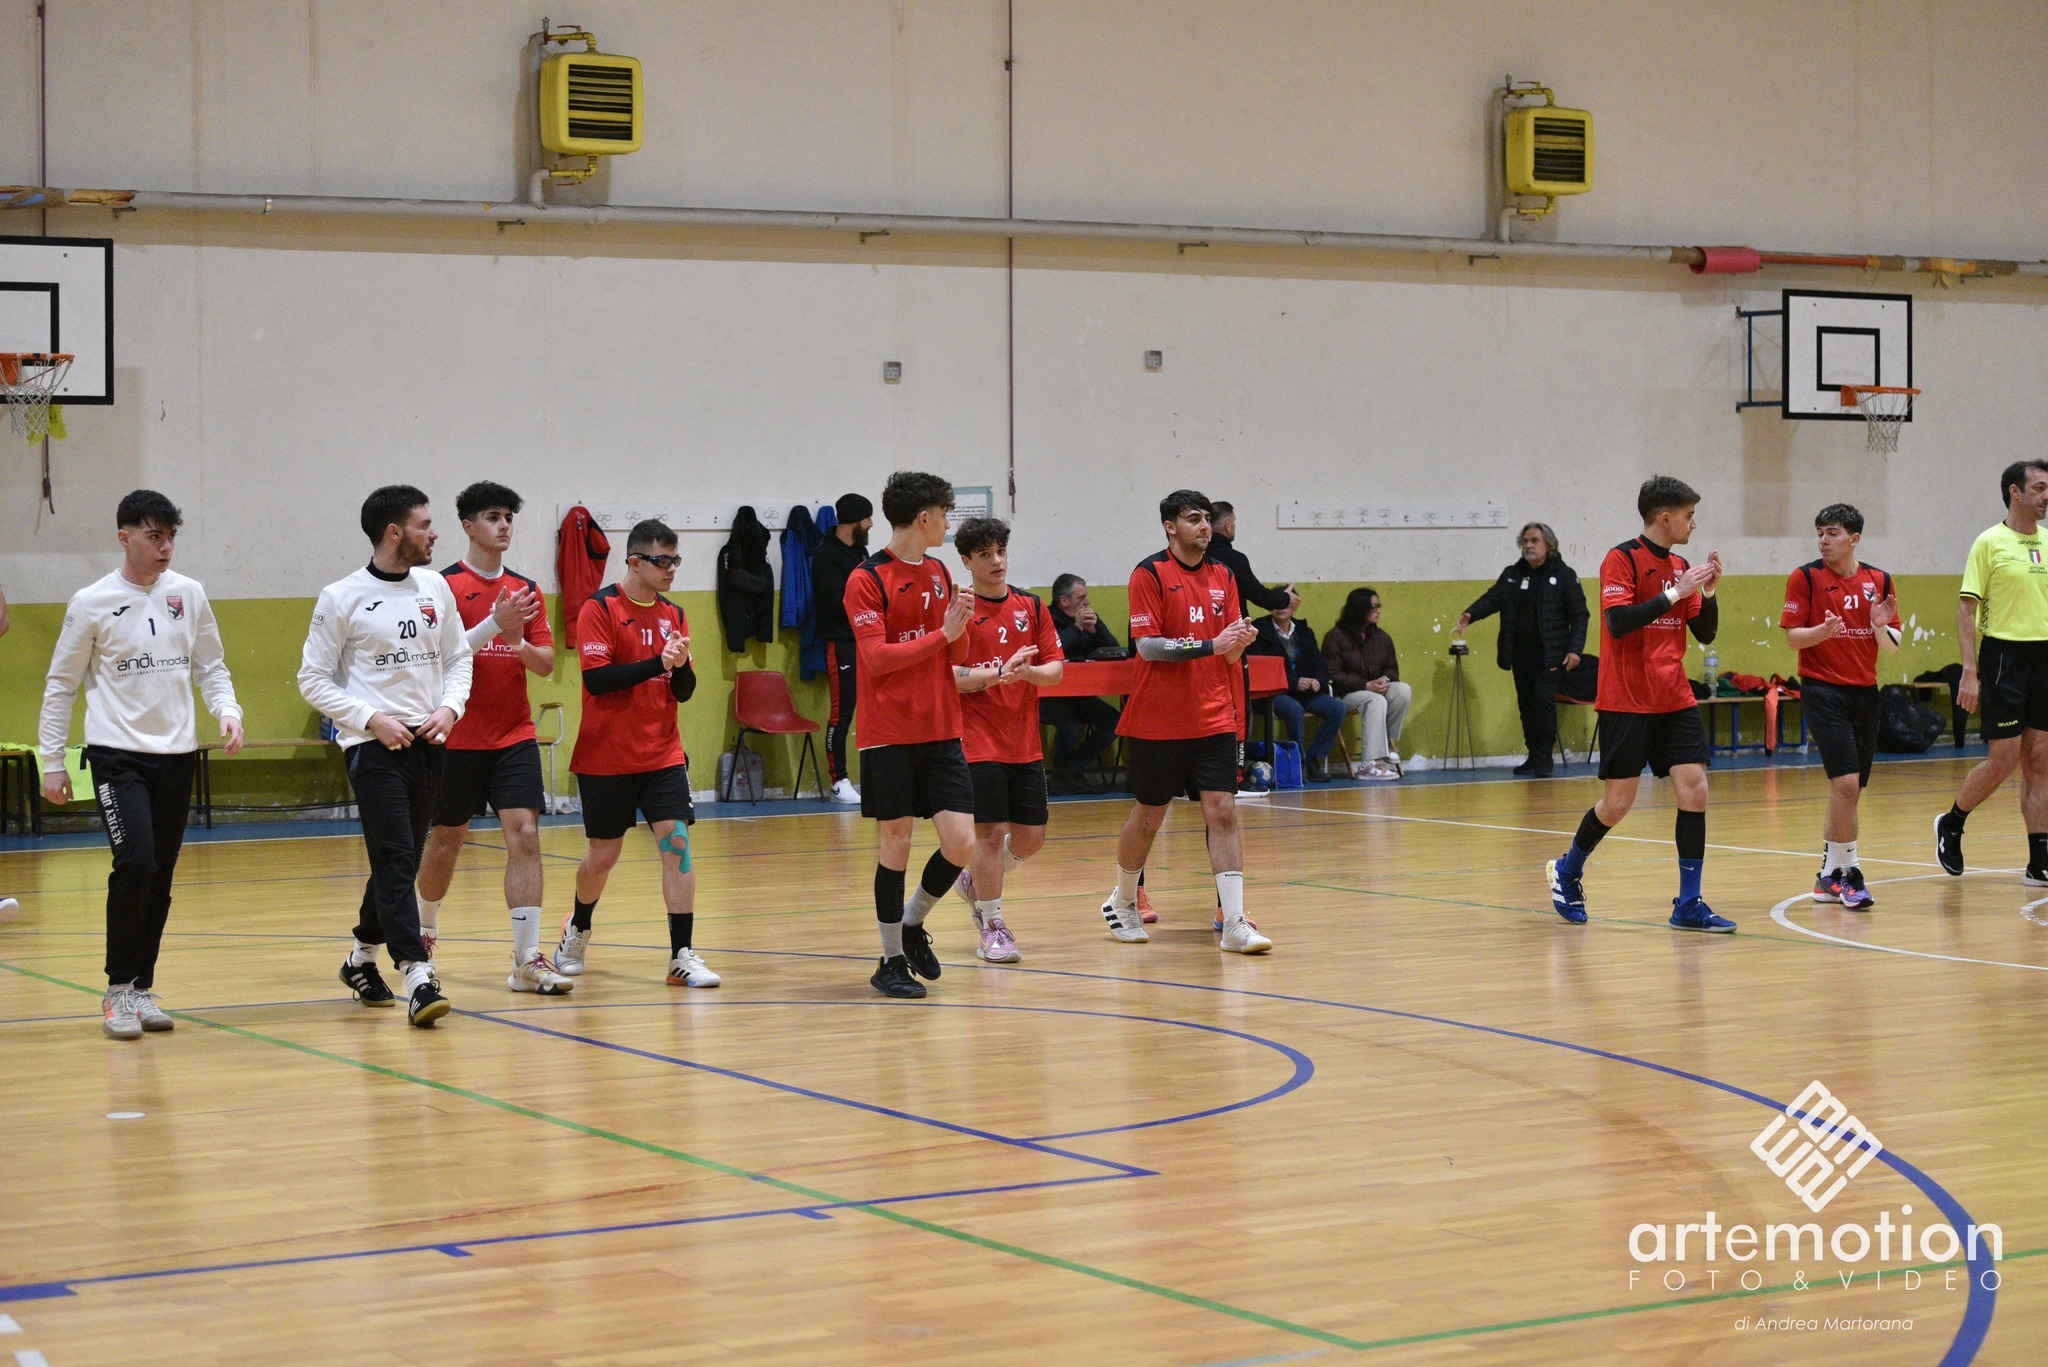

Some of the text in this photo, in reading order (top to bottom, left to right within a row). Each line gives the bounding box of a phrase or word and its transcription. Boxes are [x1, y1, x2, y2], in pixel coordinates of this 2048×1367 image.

[922, 591, 931, 610] 7
[1844, 594, 1859, 610] 21
[854, 611, 878, 623] MOOD
[1130, 614, 1151, 623] MOOD
[1189, 605, 1205, 623] 84
[148, 617, 156, 636] 1
[397, 619, 418, 640] 20
[998, 626, 1008, 644] 2
[641, 628, 653, 646] 11
[374, 646, 411, 666] andi
[583, 642, 607, 653] MOOD
[117, 652, 189, 672] andi moda
[105, 808, 124, 846] KEYJEY
